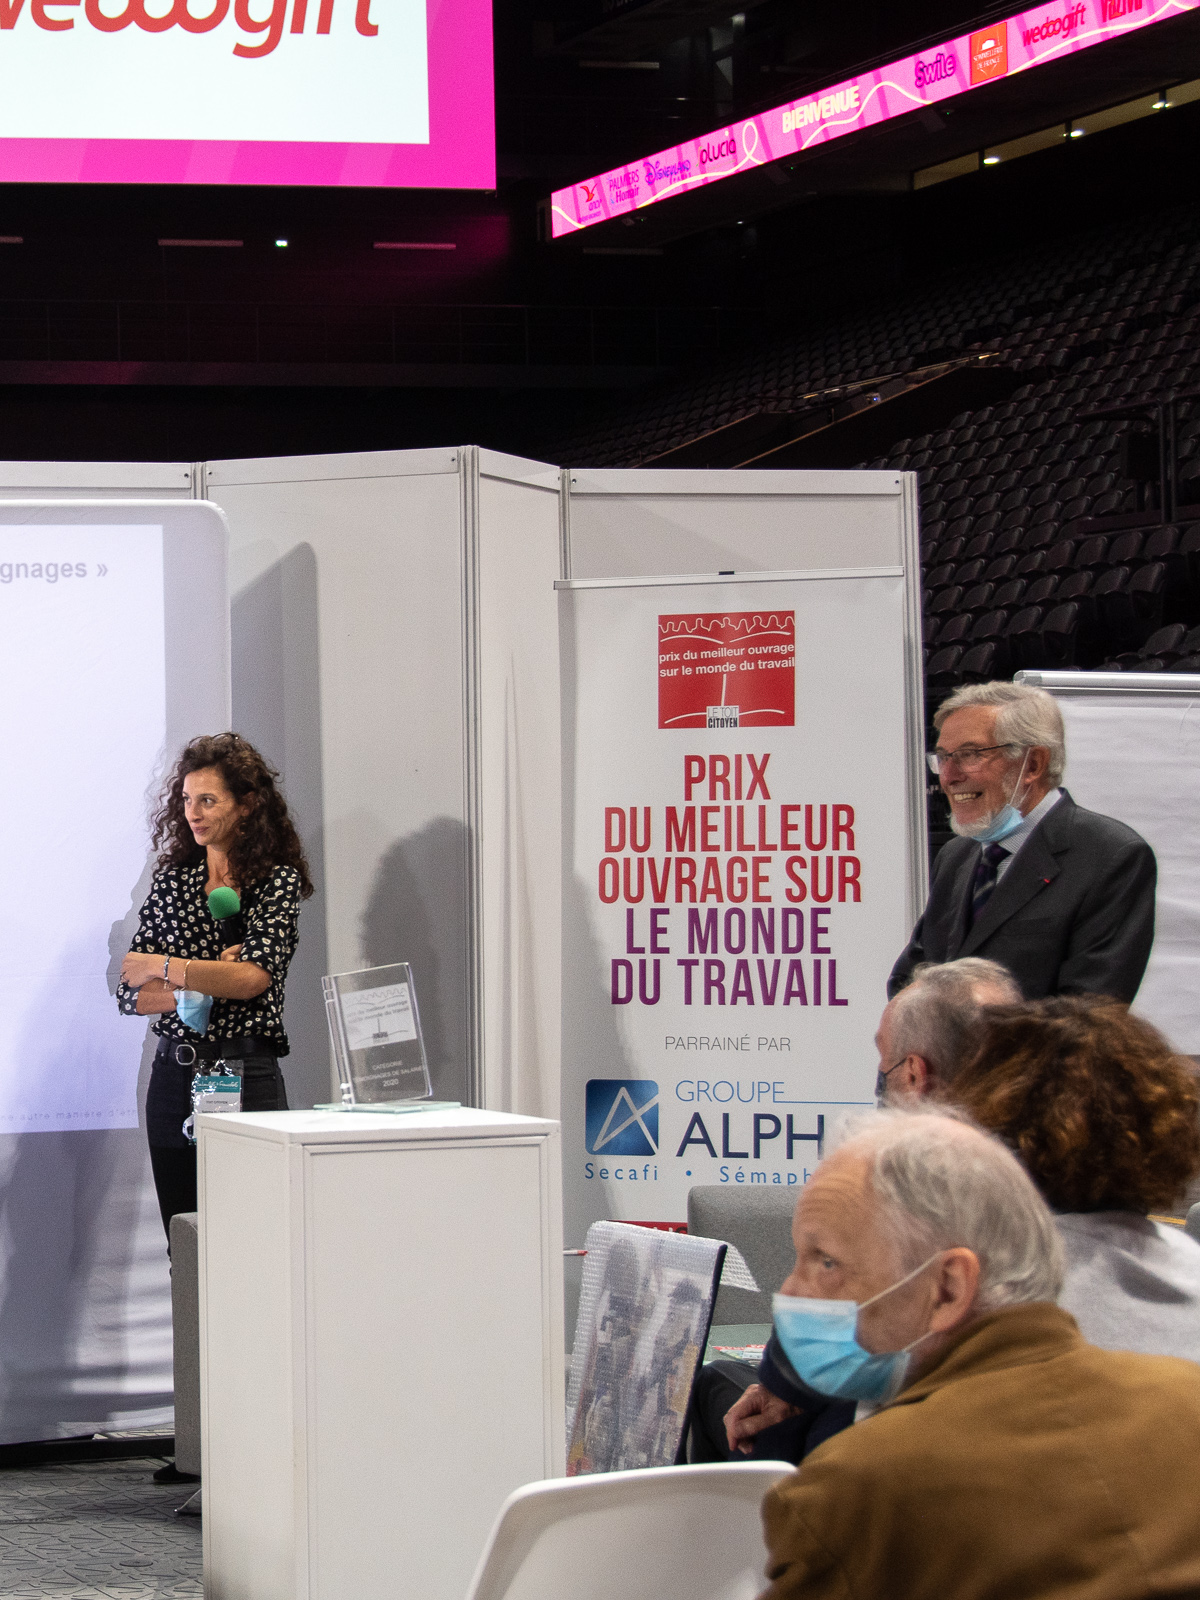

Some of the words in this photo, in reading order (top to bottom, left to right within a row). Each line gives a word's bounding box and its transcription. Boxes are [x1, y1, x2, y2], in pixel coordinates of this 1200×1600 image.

[914, 52, 957, 89] Swile
[781, 85, 860, 134] BIENVENUE
[659, 652, 681, 664] prix
[683, 650, 697, 660] du
[700, 647, 745, 659] meilleur
[748, 643, 795, 655] ouvrage
[659, 667, 679, 678] sur
[682, 665, 692, 676] le
[696, 662, 736, 675] monde
[740, 661, 754, 671] du
[758, 656, 795, 669] travail
[707, 718, 738, 729] CITOYEN
[684, 753, 772, 801] PRIX
[604, 806, 651, 853] DU
[665, 804, 855, 852] MEILLEUR
[598, 856, 772, 904] OUVRAGE
[785, 855, 862, 903] SUR
[626, 907, 670, 954] LE
[687, 907, 831, 955] MONDE
[611, 958, 661, 1006] DU
[676, 958, 849, 1006] TRAVAIL
[665, 1034, 751, 1052] PARRAINÉ
[757, 1037, 791, 1051] PAR
[675, 1079, 785, 1103] GROUPE
[676, 1112, 825, 1160] ALPH
[585, 1162, 658, 1181] Secafi
[719, 1165, 812, 1186] Sémaph
